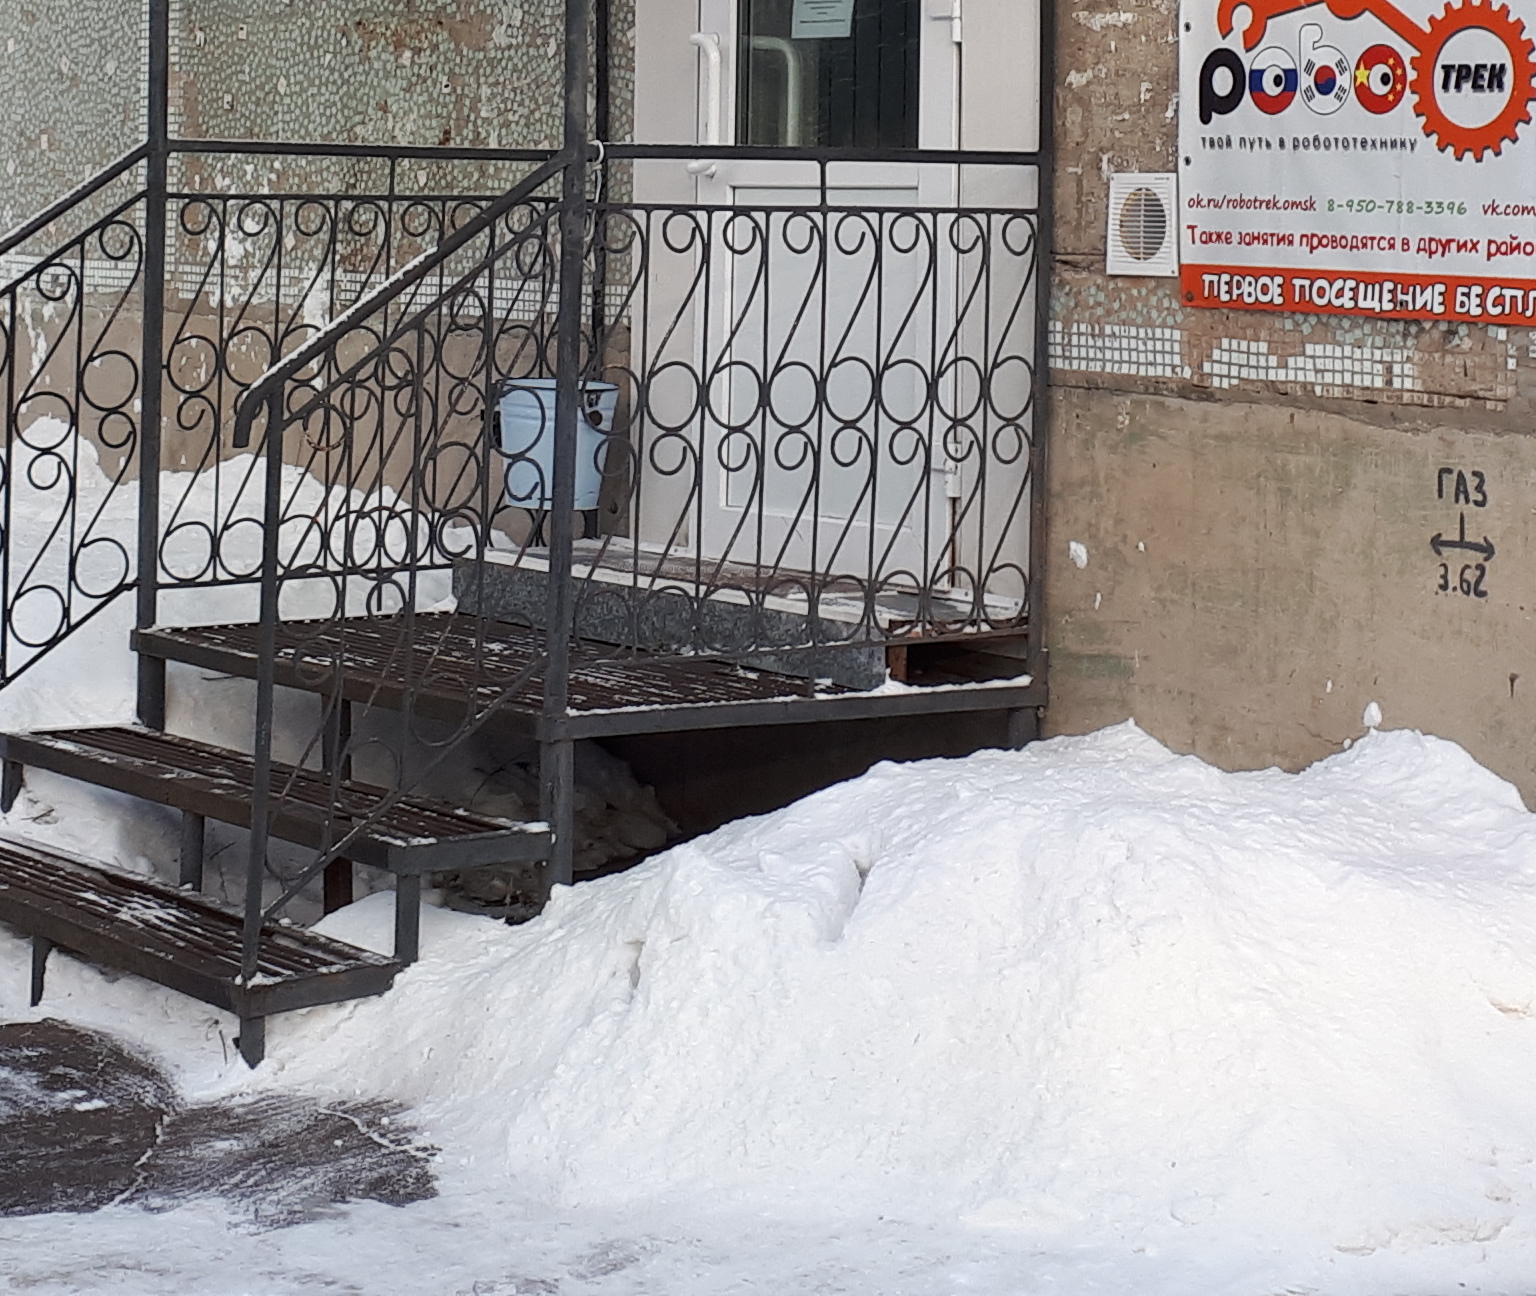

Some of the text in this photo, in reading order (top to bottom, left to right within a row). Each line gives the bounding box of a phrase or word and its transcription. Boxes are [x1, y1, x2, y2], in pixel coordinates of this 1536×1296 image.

[1440, 63, 1507, 94] ТРЕК
[1201, 134, 1418, 153] твой путь в робототехнику
[1327, 198, 1468, 216] 8-950-788-3396
[1186, 224, 1233, 245] Также
[1237, 230, 1295, 247] занятия
[1299, 232, 1396, 254] проводятся
[1401, 237, 1411, 252] в
[1416, 236, 1480, 259] других
[1201, 273, 1285, 306] ПЕРВОЕ
[1291, 276, 1447, 315] ПОСЕЩЕНИЕ
[1437, 467, 1489, 508] ГАЗ
[1437, 562, 1489, 599] 3.62
